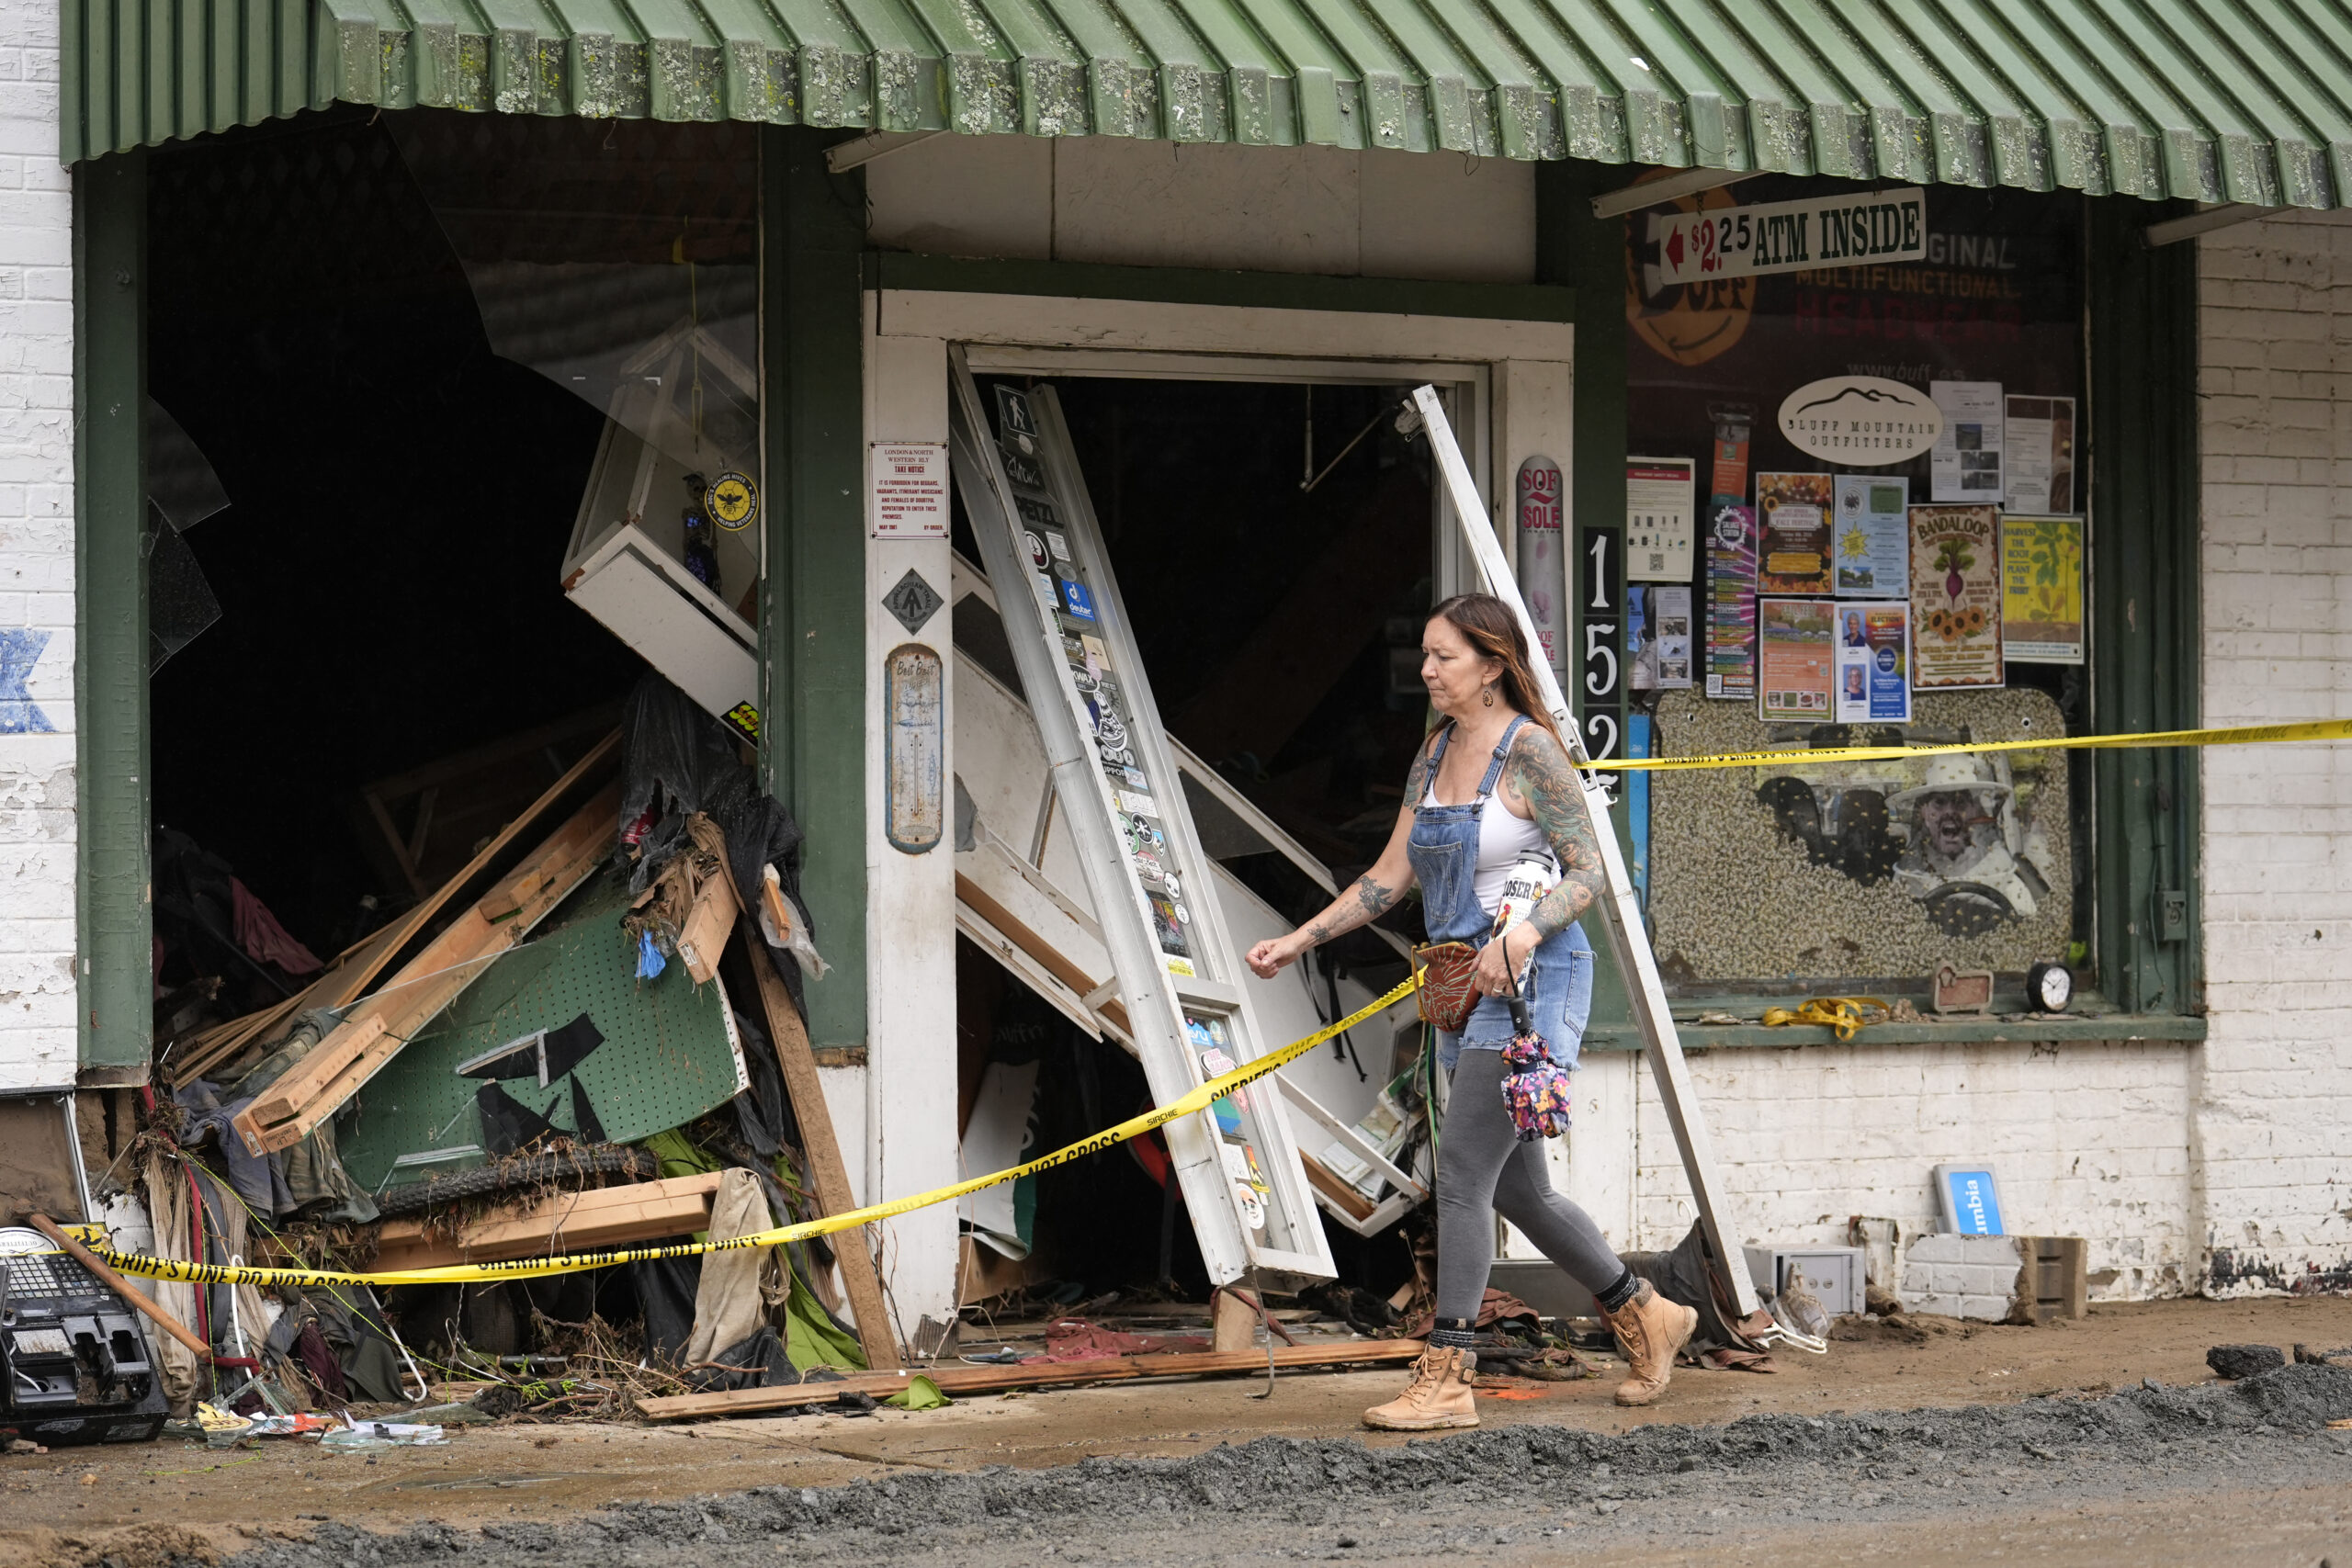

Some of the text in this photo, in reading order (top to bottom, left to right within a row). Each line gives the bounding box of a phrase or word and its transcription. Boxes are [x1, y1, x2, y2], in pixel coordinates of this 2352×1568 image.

[1753, 213, 1809, 266] ATM
[1820, 201, 1921, 260] INSIDE
[1795, 267, 2021, 299] MULTIFUNCTIONAL
[1795, 292, 2020, 344] HEADWEAR
[1788, 419, 1935, 434] BLUFF MOUNTAIN
[1810, 435, 1914, 449] OUTFITTERS
[713, 473, 746, 489] HEALING HIVES
[1522, 468, 1560, 491] SOF
[717, 516, 737, 527] HELPING
[736, 507, 755, 526] VETERANS
[1523, 505, 1561, 529] SOLE
[1917, 516, 1990, 540] BANDALOOP
[2005, 528, 2036, 536] HARVEST
[2011, 538, 2025, 547] THE
[2007, 549, 2030, 558] ROOT
[2007, 565, 2030, 574] PLANT
[2012, 576, 2025, 584] THE
[893, 581, 932, 610] APPALACHIAN TRAIL
[1069, 602, 1091, 615] deuter
[897, 661, 915, 677] Best
[1147, 1108, 1179, 1126] SIRCHIE
[792, 1227, 827, 1241] SIRCHIE
[185, 1264, 229, 1284] LINE
